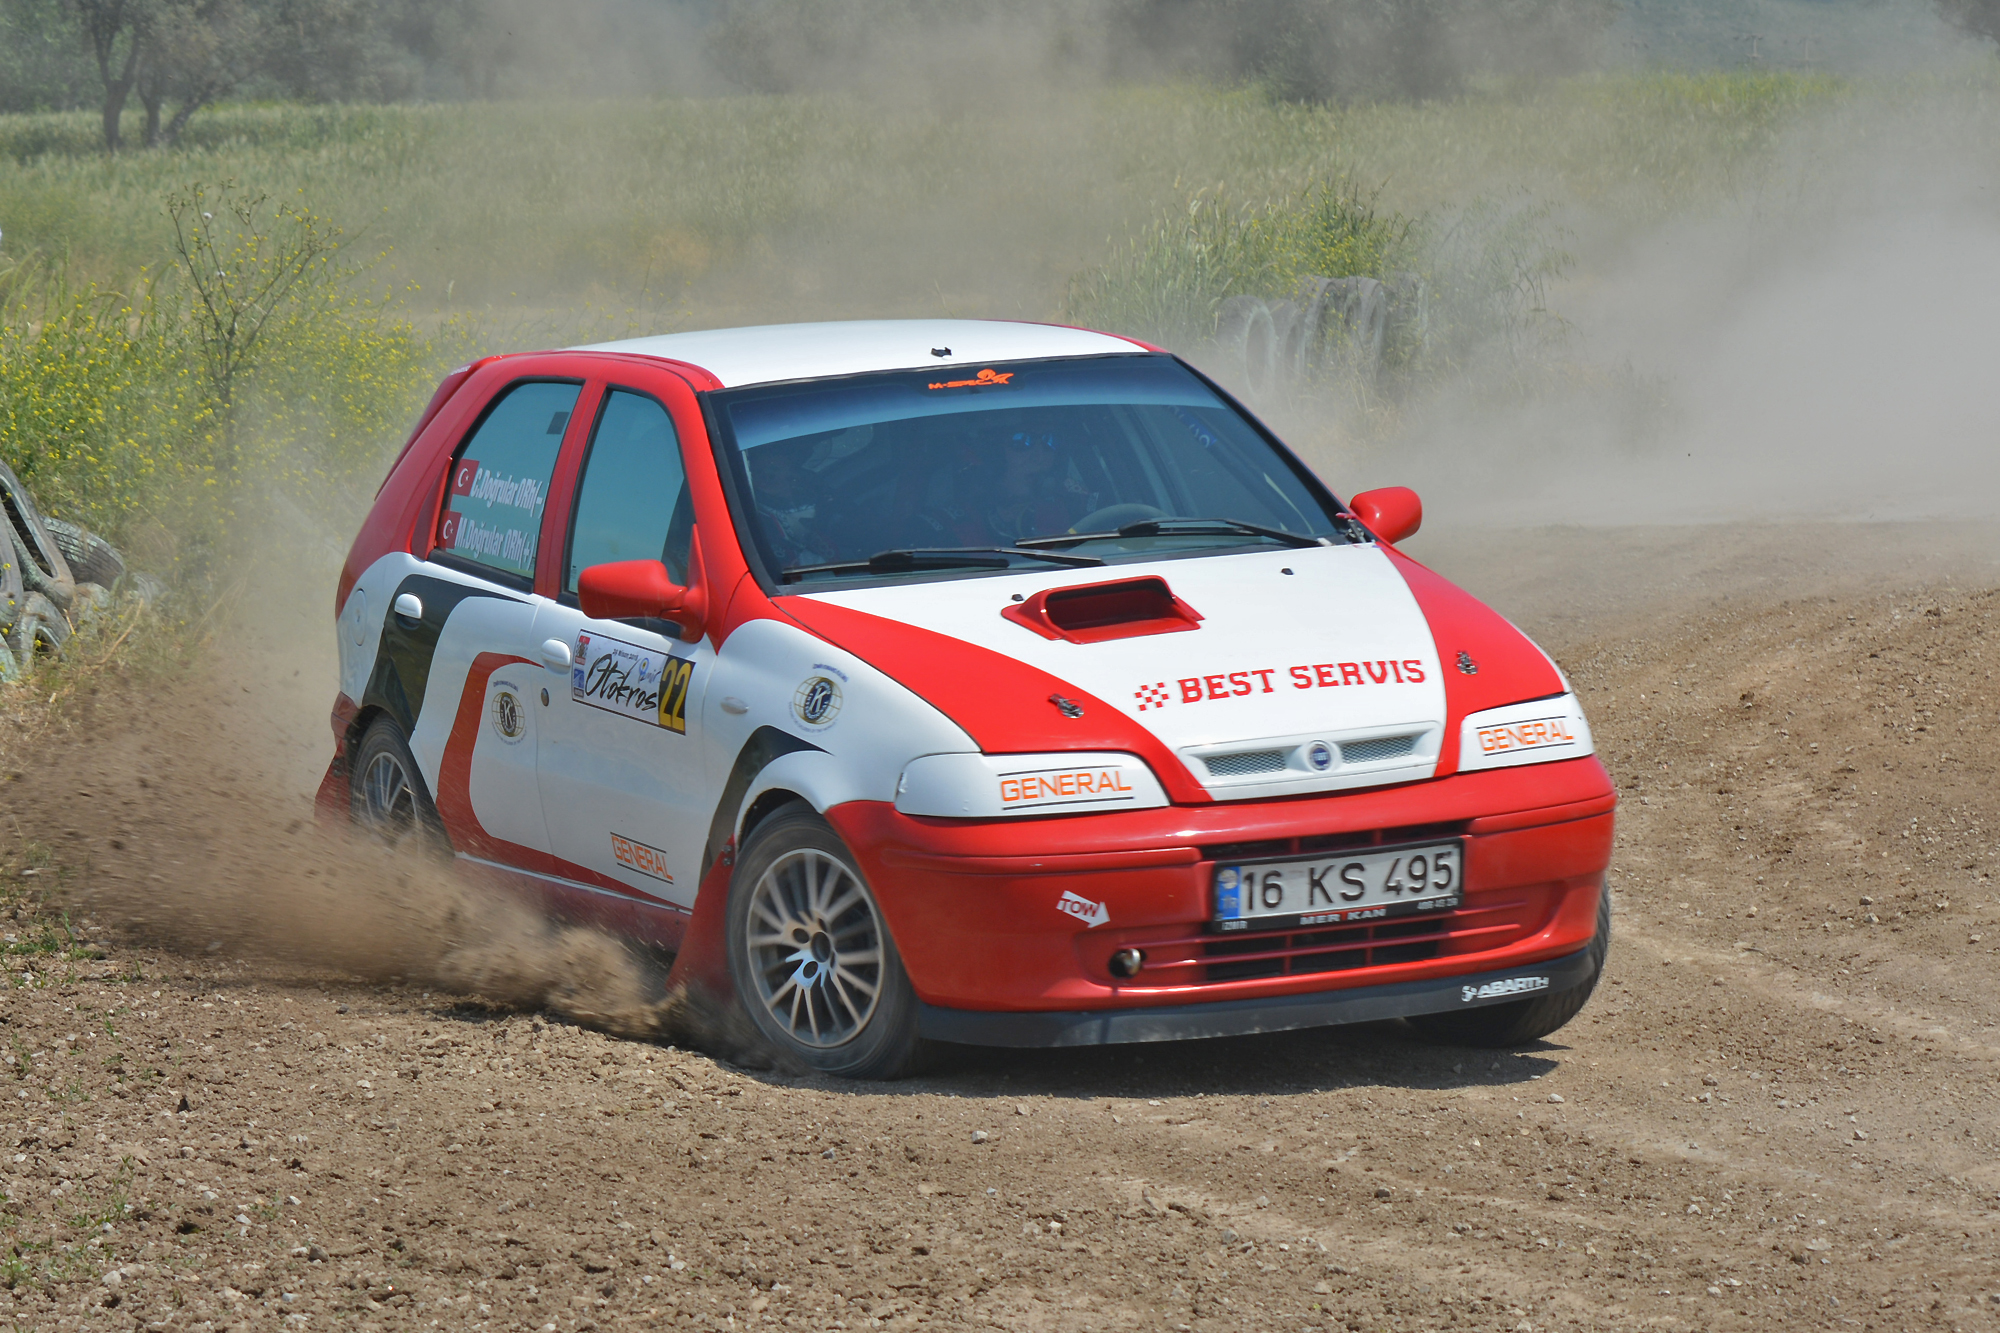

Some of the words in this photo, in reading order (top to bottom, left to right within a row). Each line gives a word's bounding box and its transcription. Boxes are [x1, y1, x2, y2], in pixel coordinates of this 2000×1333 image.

[659, 658, 692, 731] 22
[1177, 668, 1275, 704] BEST
[1290, 660, 1427, 690] SERVIS
[1477, 720, 1575, 752] GENERAL
[1000, 769, 1132, 802] GENERAL
[612, 835, 673, 881] GENERAL
[1242, 870, 1283, 910] 16
[1308, 861, 1366, 906] KS
[1384, 850, 1453, 896] 495
[1061, 897, 1100, 917] TOW
[1299, 912, 1341, 925] MER
[1347, 908, 1386, 921] KAN
[1477, 976, 1549, 996] ABARTH
